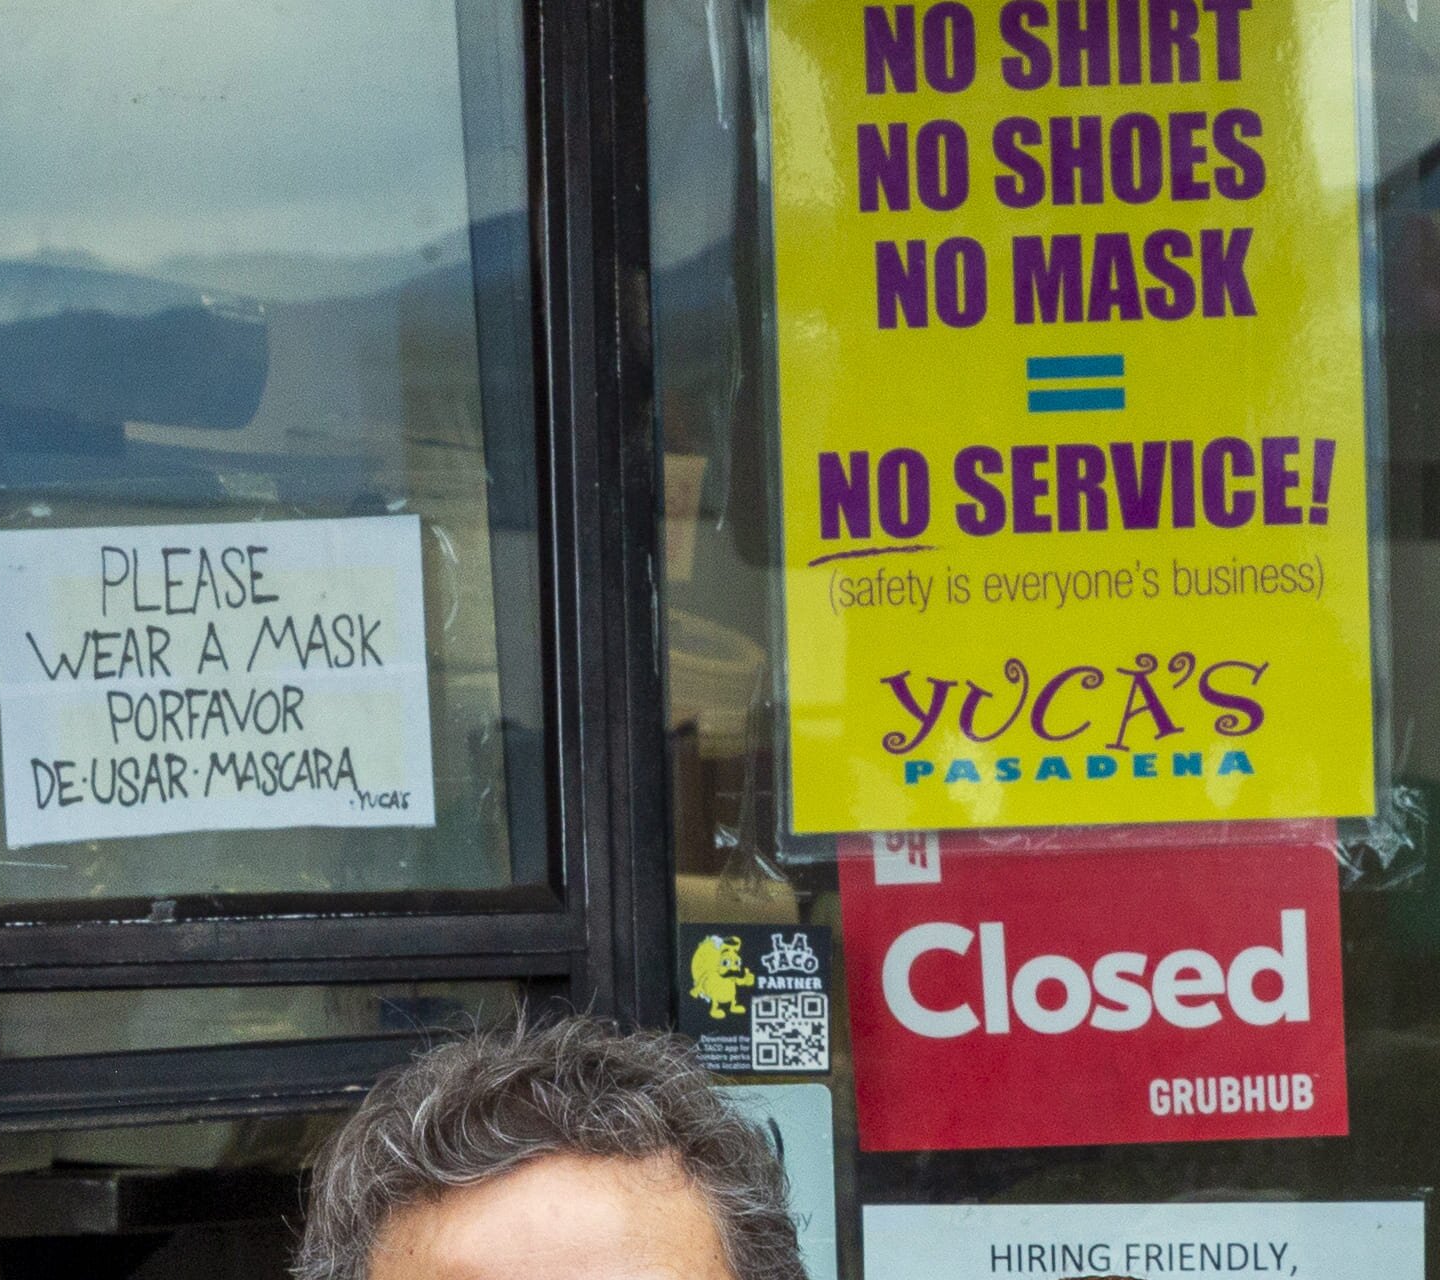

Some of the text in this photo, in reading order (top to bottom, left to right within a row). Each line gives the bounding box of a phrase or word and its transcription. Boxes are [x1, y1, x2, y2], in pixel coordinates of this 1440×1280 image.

[863, 0, 1253, 97] NO SHIRT
[858, 108, 1267, 213] NO SHOES
[875, 228, 1258, 330] NO MASK
[819, 436, 1336, 541] NO SERVICE!
[101, 545, 279, 617] PLEASE
[829, 554, 1324, 613] (safety is everyone's business)
[27, 614, 383, 681] WEAR A MASK
[107, 685, 304, 744] PORFAVOR
[880, 651, 1270, 756] YUCA'S
[904, 750, 1255, 785] PASADENA
[758, 977, 822, 989] PARTNER
[761, 952, 818, 974] TACO
[881, 908, 1311, 1040] Closed
[1149, 1074, 1315, 1116] GRUBHUB
[991, 1242, 1298, 1276] HIRING FRIENDLY,
